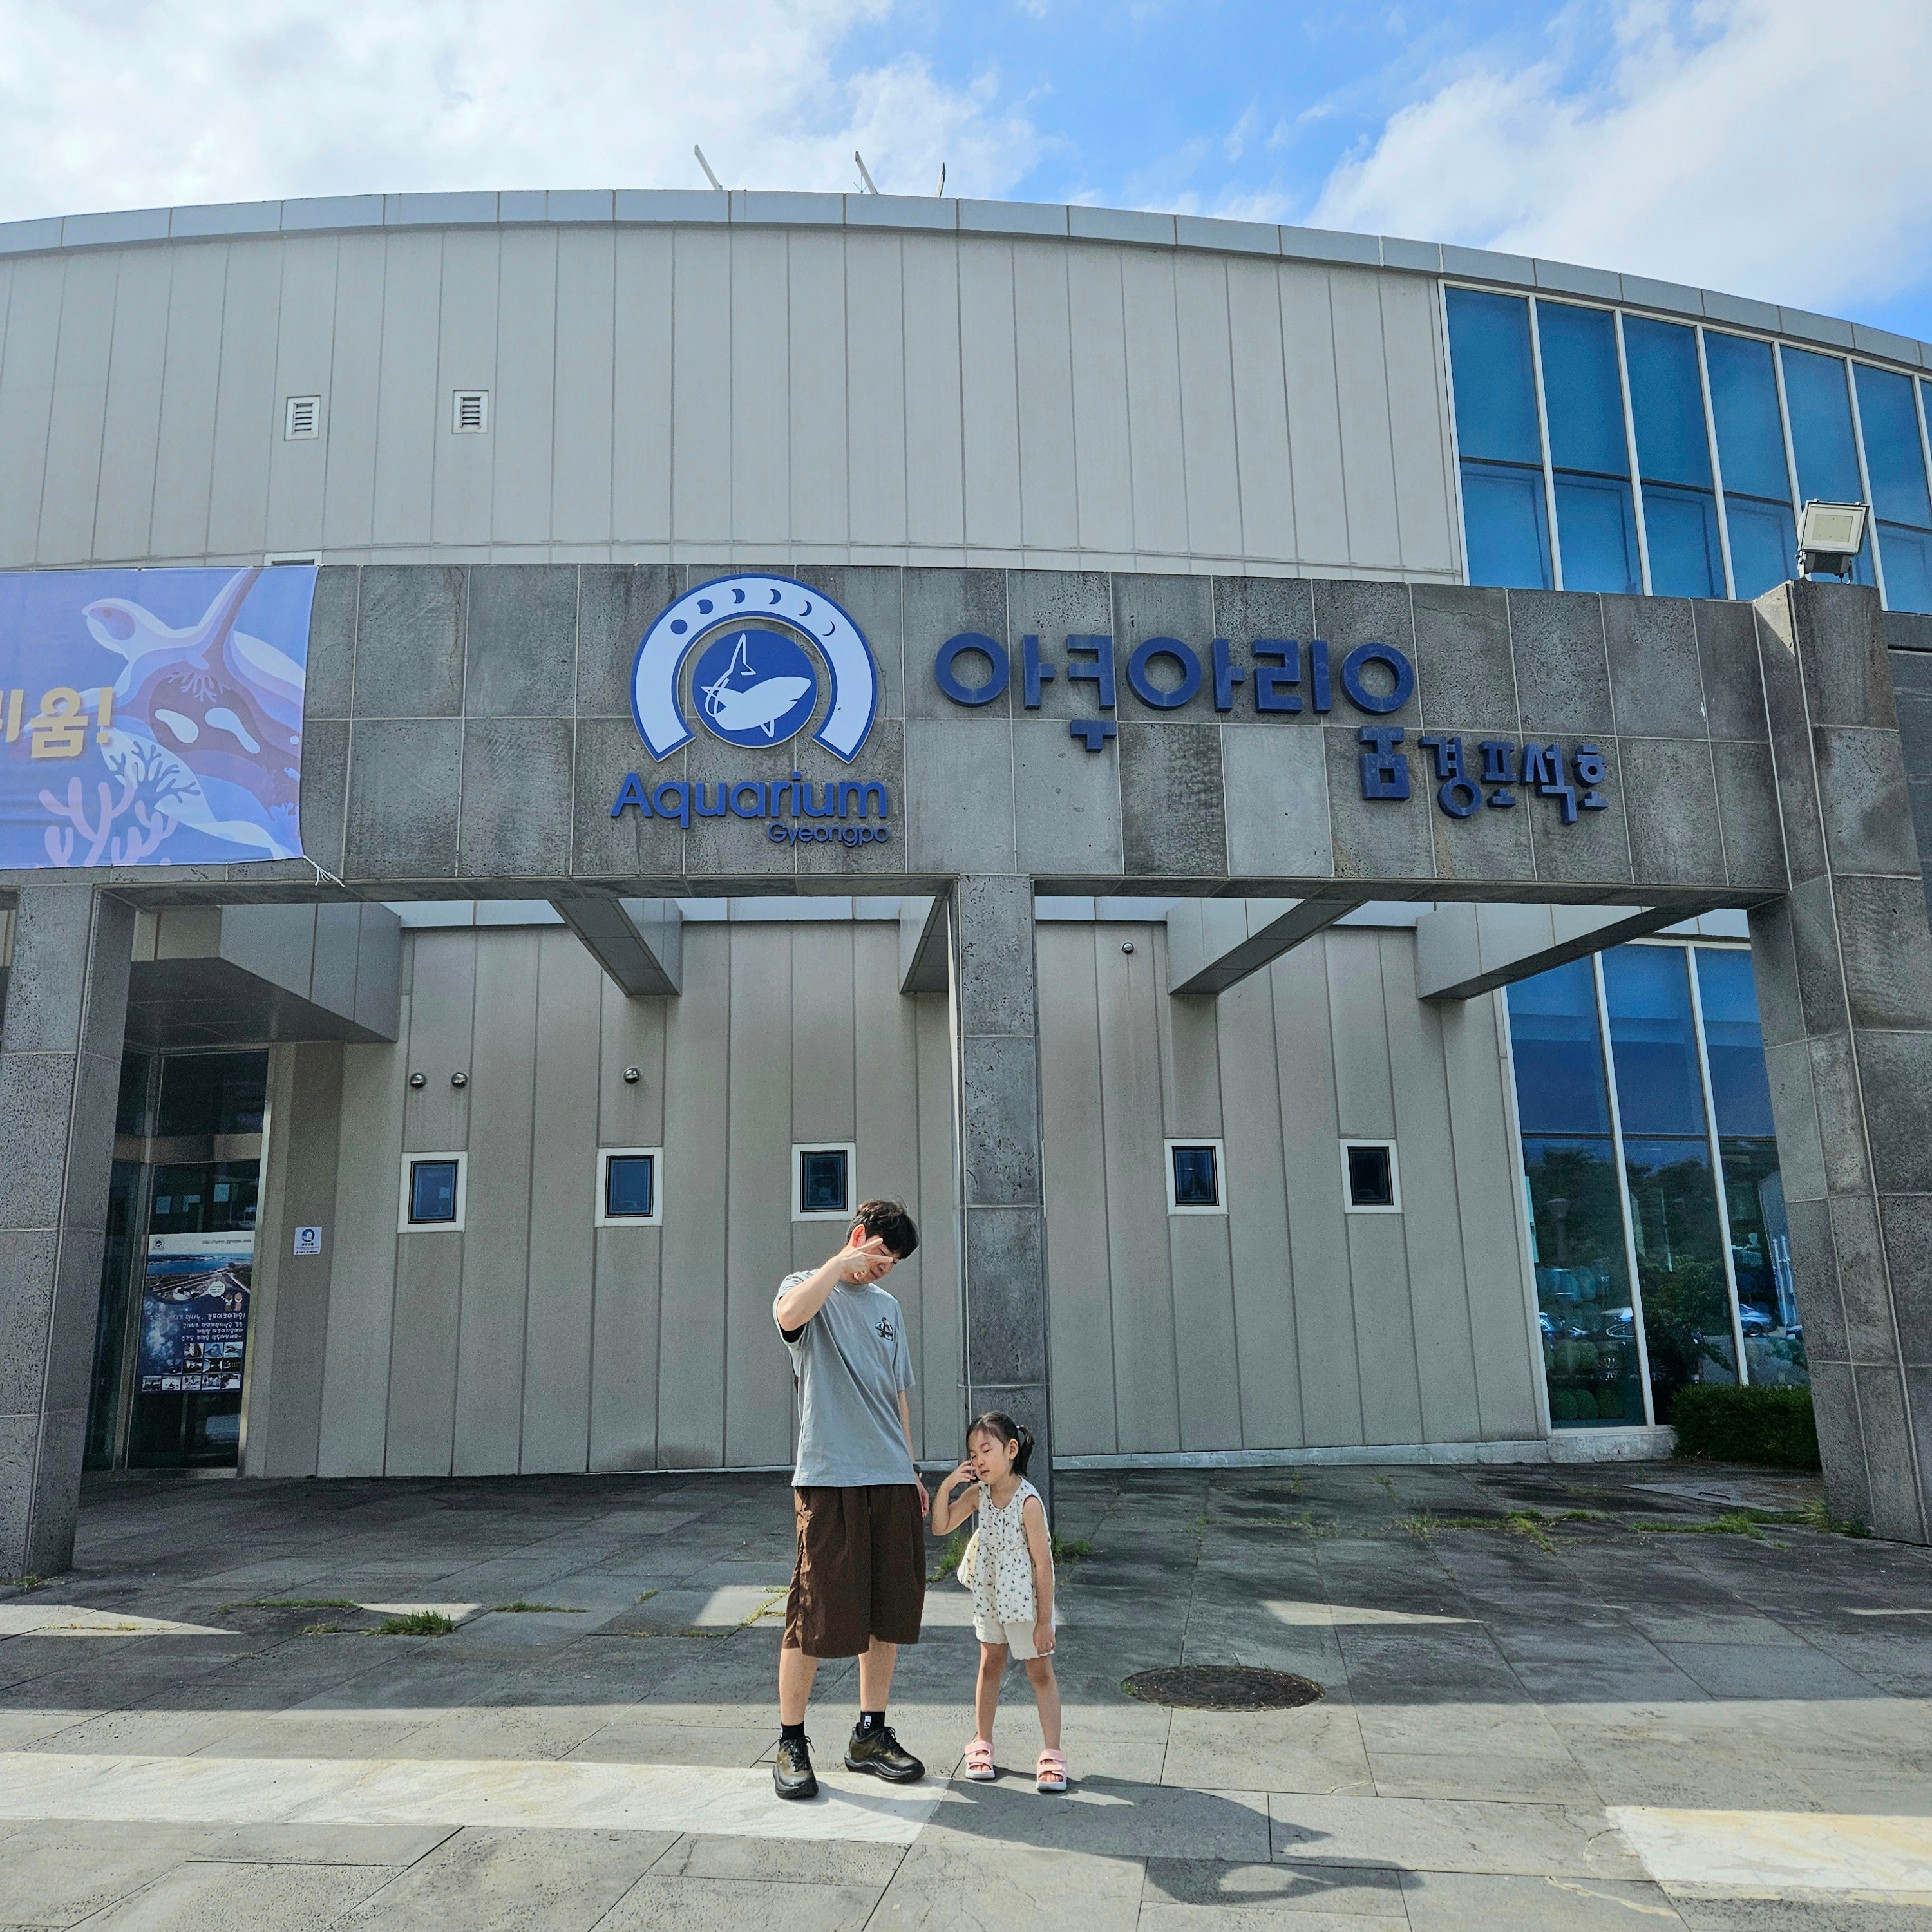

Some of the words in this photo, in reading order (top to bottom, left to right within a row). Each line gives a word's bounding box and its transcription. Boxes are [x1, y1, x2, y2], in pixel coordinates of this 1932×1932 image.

[934, 632, 1415, 802] 아쿠아리움
[610, 770, 888, 828] Aquarium
[1417, 735, 1609, 825] 경포석호
[767, 822, 890, 848] Gyeongpo
